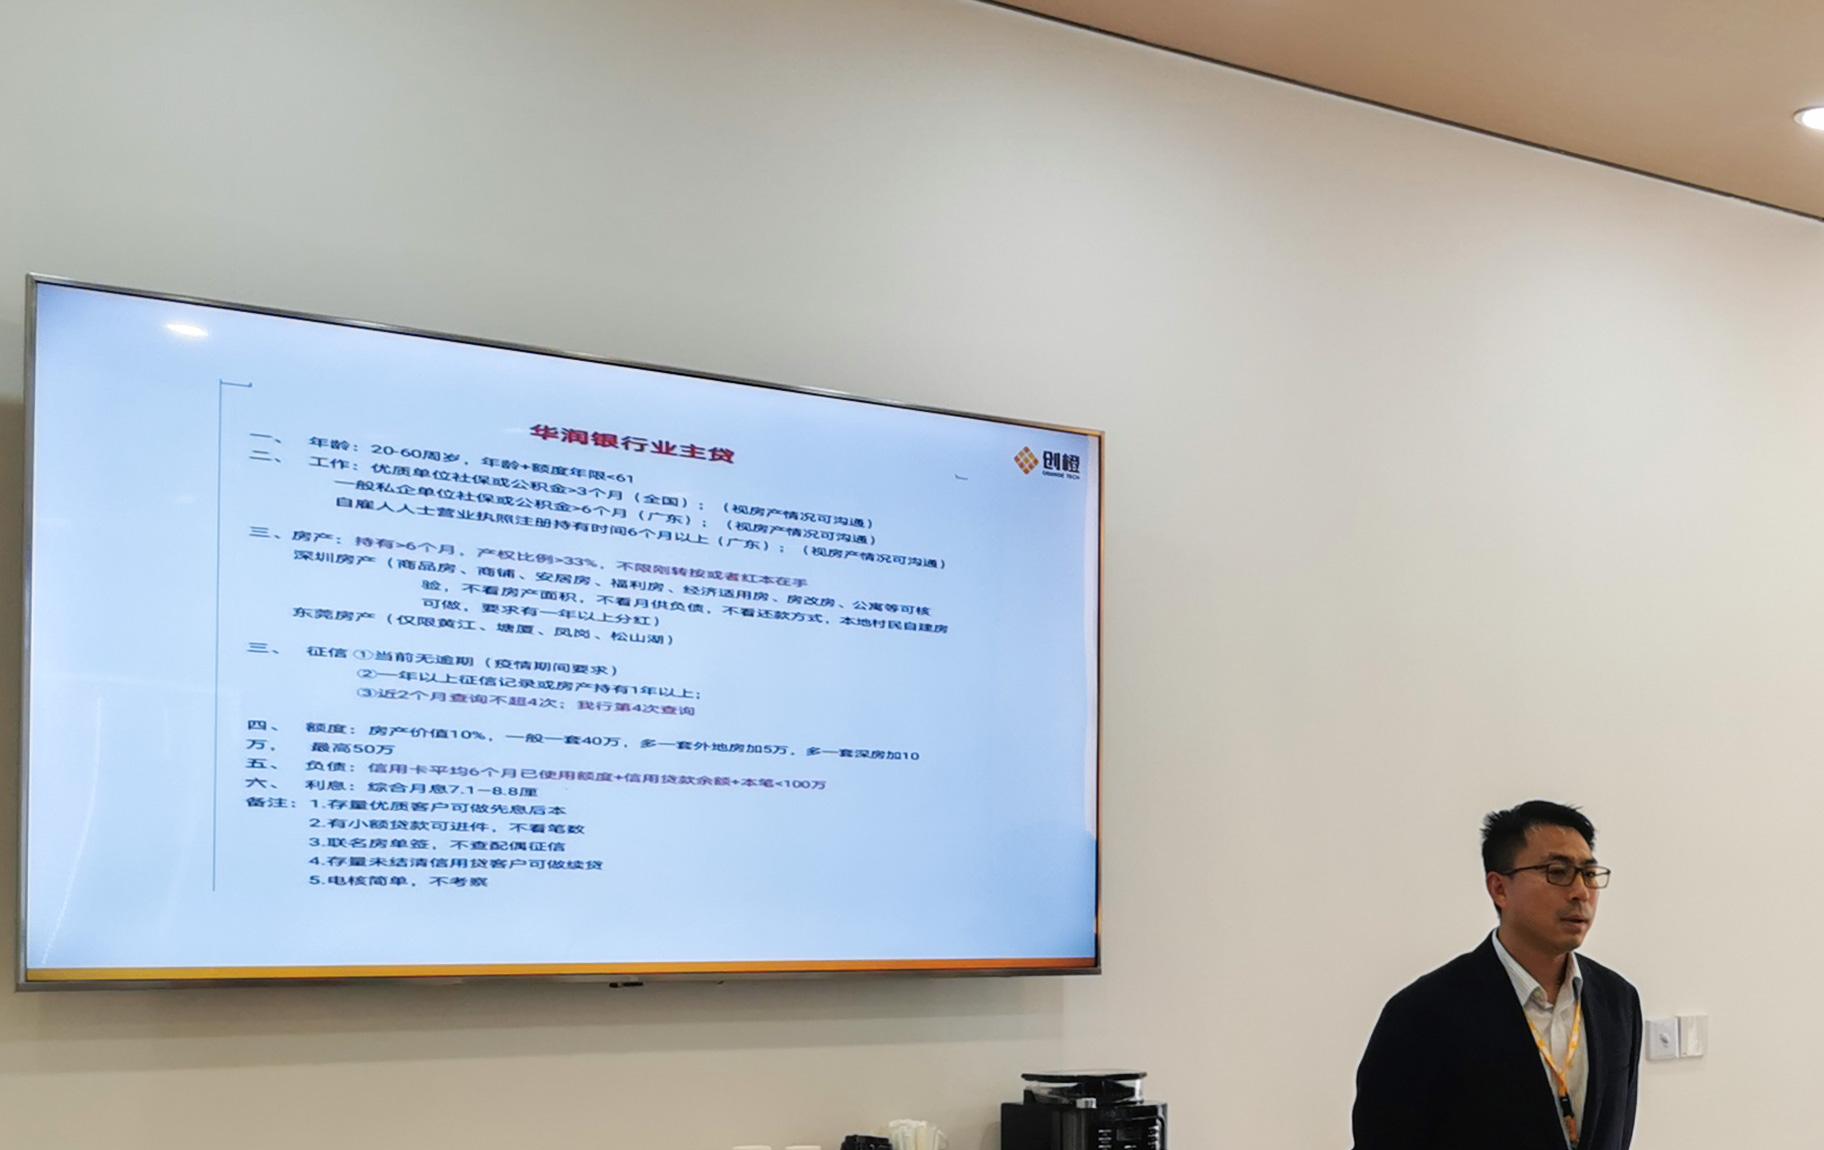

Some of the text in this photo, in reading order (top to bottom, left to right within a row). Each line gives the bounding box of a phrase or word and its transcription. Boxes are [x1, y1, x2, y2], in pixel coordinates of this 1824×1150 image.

[530, 423, 735, 463] 华润银行业主贷
[311, 741, 396, 756] 最高50万
